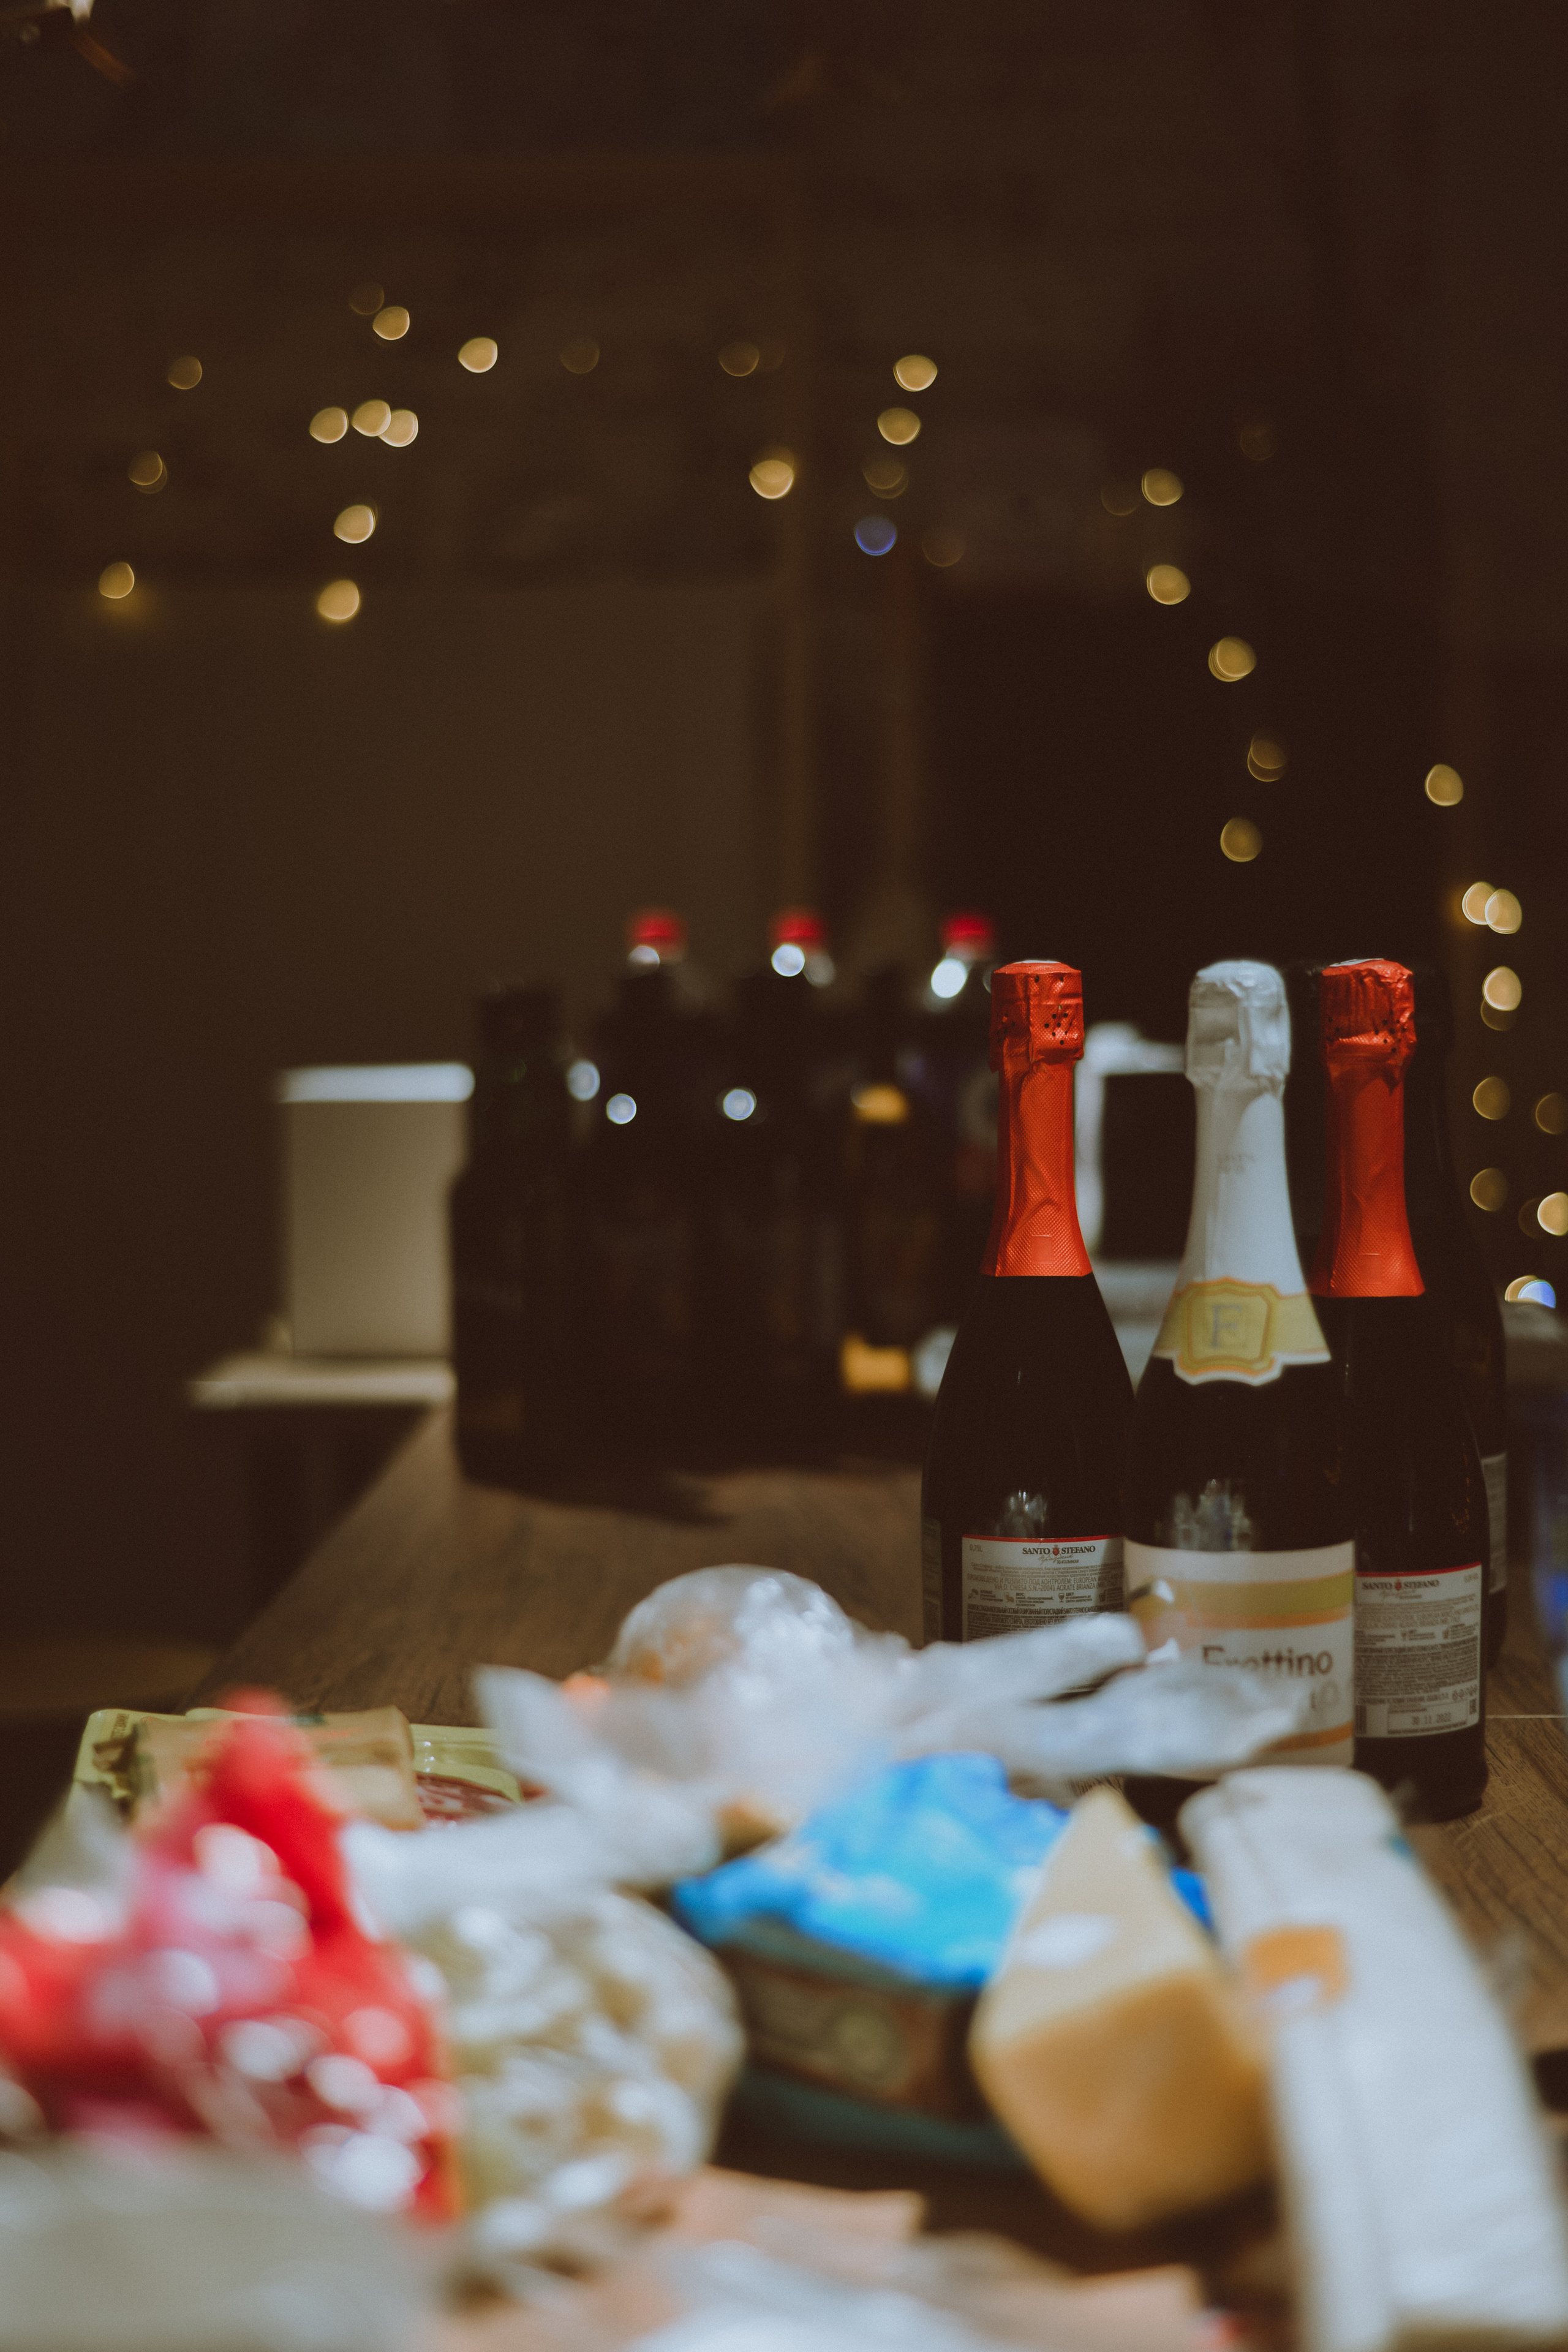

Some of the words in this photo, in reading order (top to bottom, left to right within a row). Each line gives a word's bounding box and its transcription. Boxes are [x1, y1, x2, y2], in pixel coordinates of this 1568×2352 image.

[1061, 1545, 1096, 1555] STEFANO
[1362, 1581, 1392, 1590] SANTO
[1403, 1580, 1439, 1589] STEFANO
